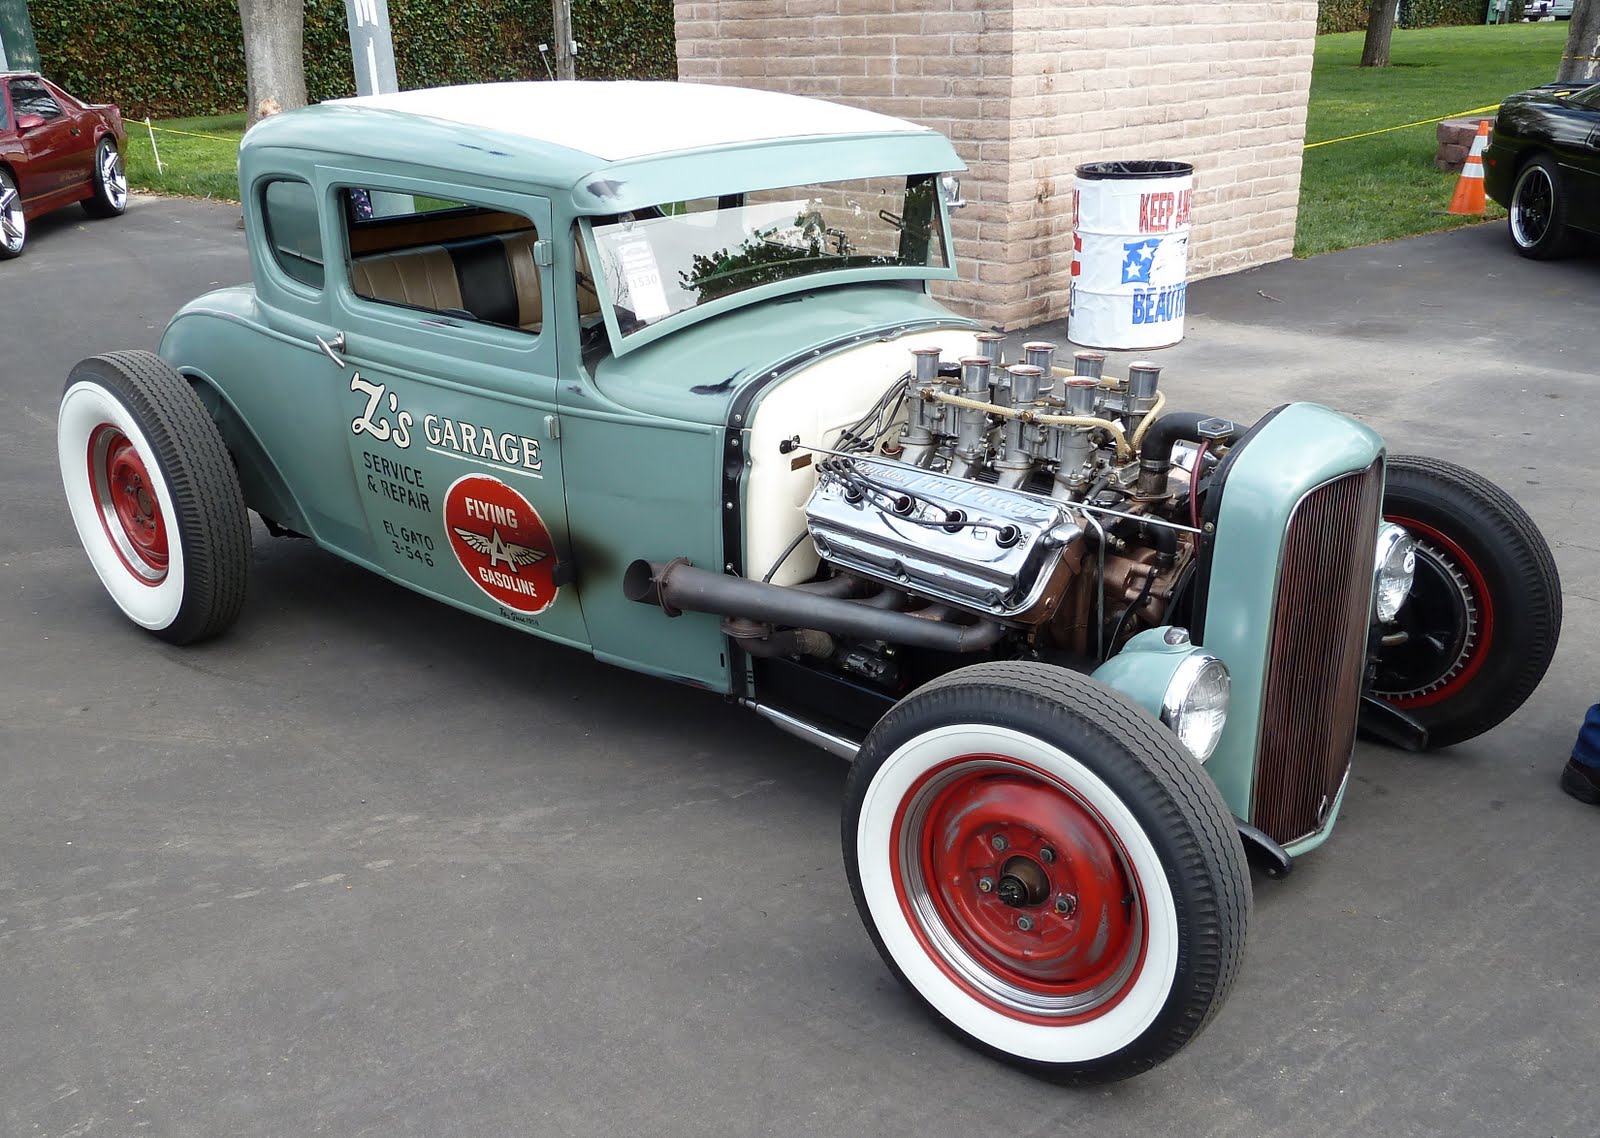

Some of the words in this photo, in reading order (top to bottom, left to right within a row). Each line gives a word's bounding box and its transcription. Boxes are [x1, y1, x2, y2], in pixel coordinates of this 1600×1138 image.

[1138, 191, 1175, 234] KEEP
[632, 273, 658, 289] 1530
[350, 371, 414, 449] Z's
[423, 414, 543, 471] GARAGE
[363, 451, 425, 489] SERVICE
[367, 475, 378, 494] &
[380, 480, 432, 513] REPAIR
[464, 496, 519, 529] FLYING
[383, 519, 399, 539] EL
[401, 526, 435, 551] GATO
[392, 540, 434, 568] 3-546
[478, 566, 538, 599] GASOLINE
